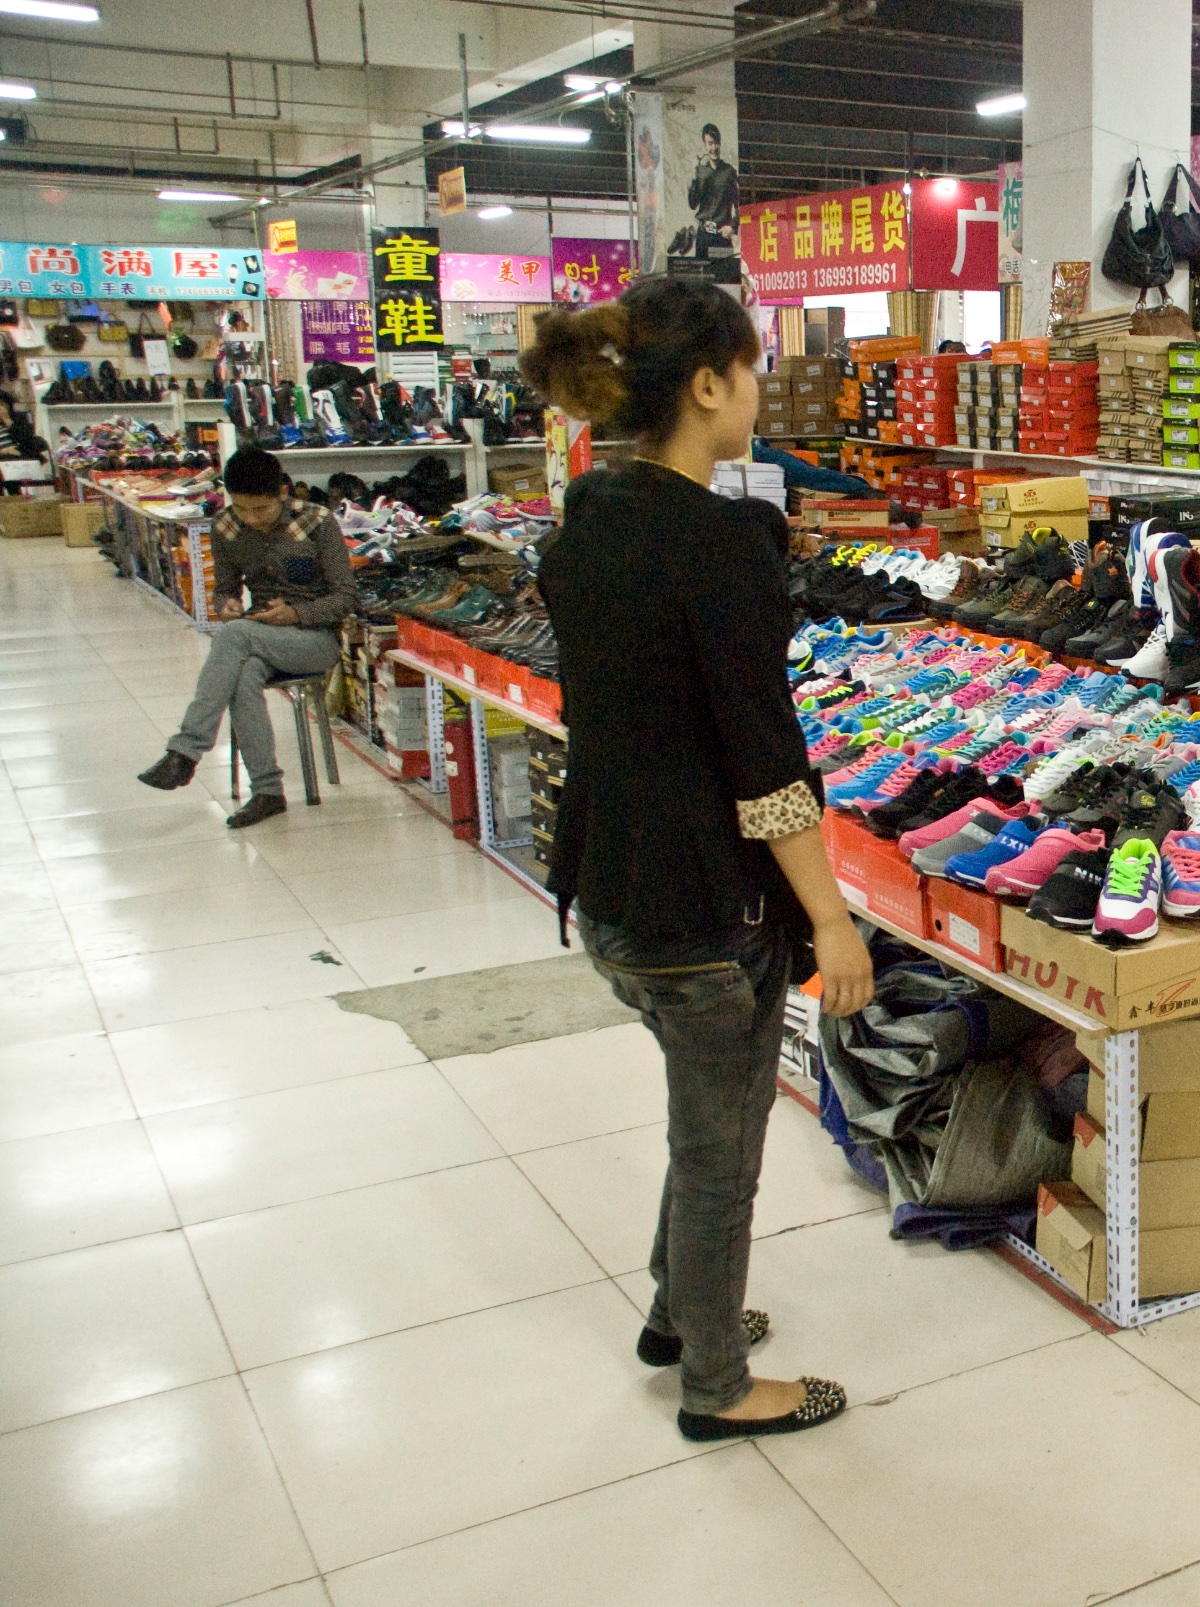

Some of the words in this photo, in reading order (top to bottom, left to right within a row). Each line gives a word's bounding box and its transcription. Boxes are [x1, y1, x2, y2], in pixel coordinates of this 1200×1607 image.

[0, 247, 222, 278] 尚满屋
[495, 258, 541, 286] 美甲
[102, 283, 135, 296] 手表
